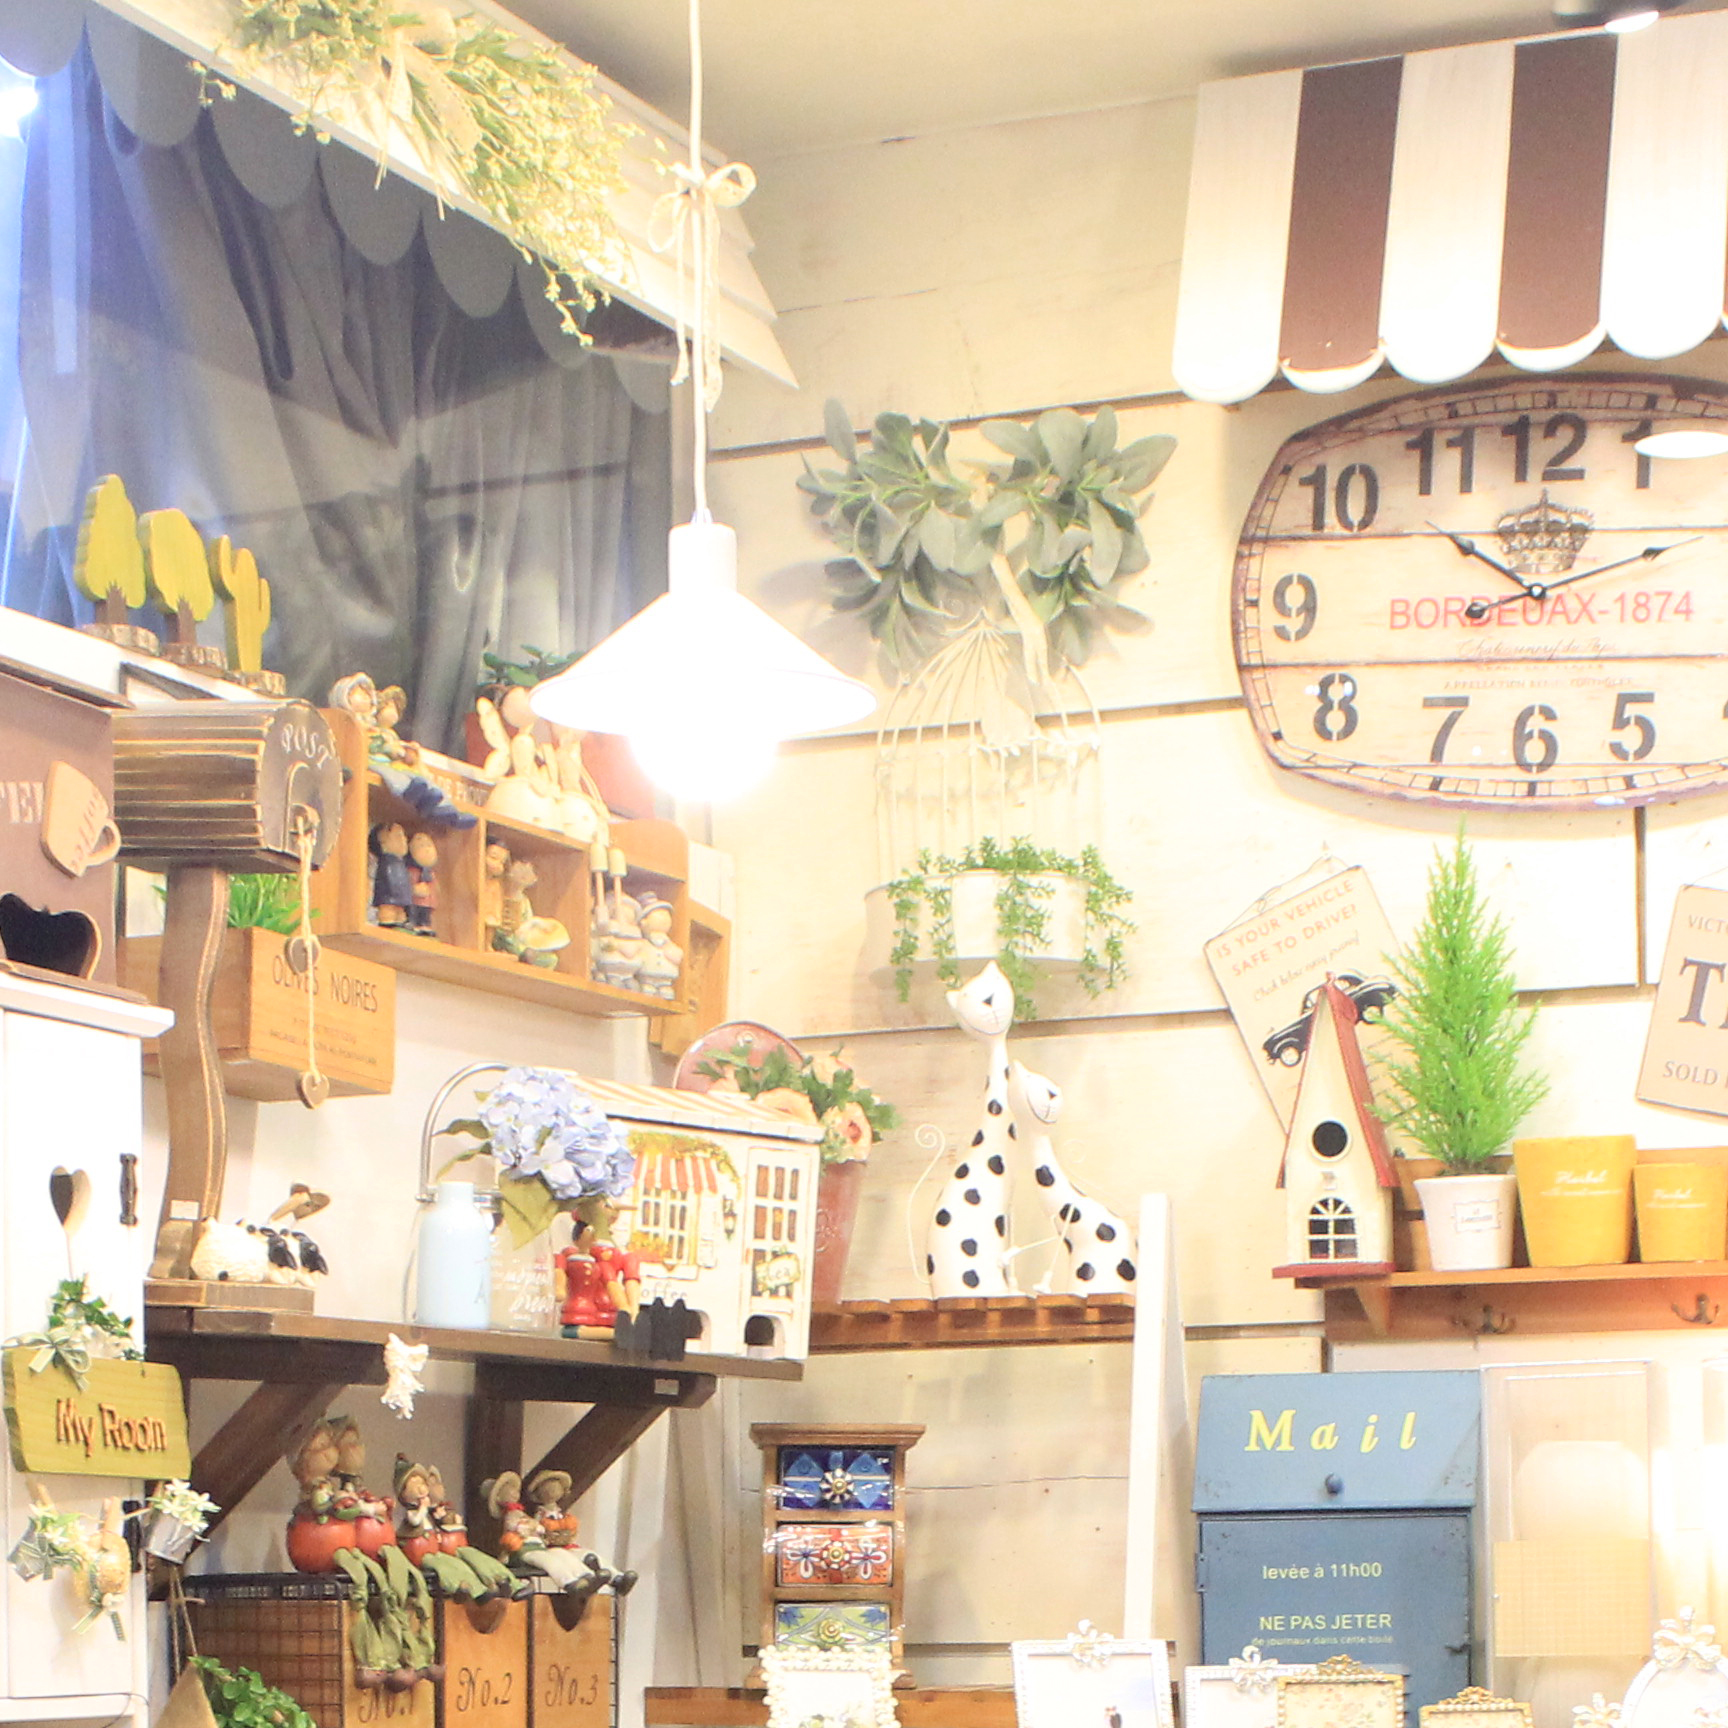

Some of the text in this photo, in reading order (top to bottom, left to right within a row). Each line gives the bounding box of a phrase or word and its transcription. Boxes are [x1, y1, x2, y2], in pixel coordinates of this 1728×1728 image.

[1406, 427, 1473, 495] 11
[1502, 412, 1587, 482] 12
[1622, 419, 1653, 489] 1
[1299, 464, 1378, 532] 10
[1273, 573, 1317, 641] 9
[1312, 673, 1359, 740] 8
[1422, 696, 1469, 763] 7
[1609, 692, 1656, 761] 5
[1512, 705, 1558, 773] 6
[1215, 880, 1355, 959] IS YOUR VEHICLE
[1232, 949, 1270, 976] SAFE
[1275, 934, 1297, 955] TO
[330, 971, 378, 1013] NOIRES
[1663, 1060, 1718, 1086] SOLD
[640, 1281, 688, 1300] offee
[57, 1398, 167, 1458] My Room
[1244, 1409, 1417, 1453] Mail
[1330, 1562, 1382, 1578] 11h00
[1259, 1613, 1393, 1631] NE PAS JETER
[456, 1667, 512, 1712] No.2
[545, 1663, 598, 1707] No.3
